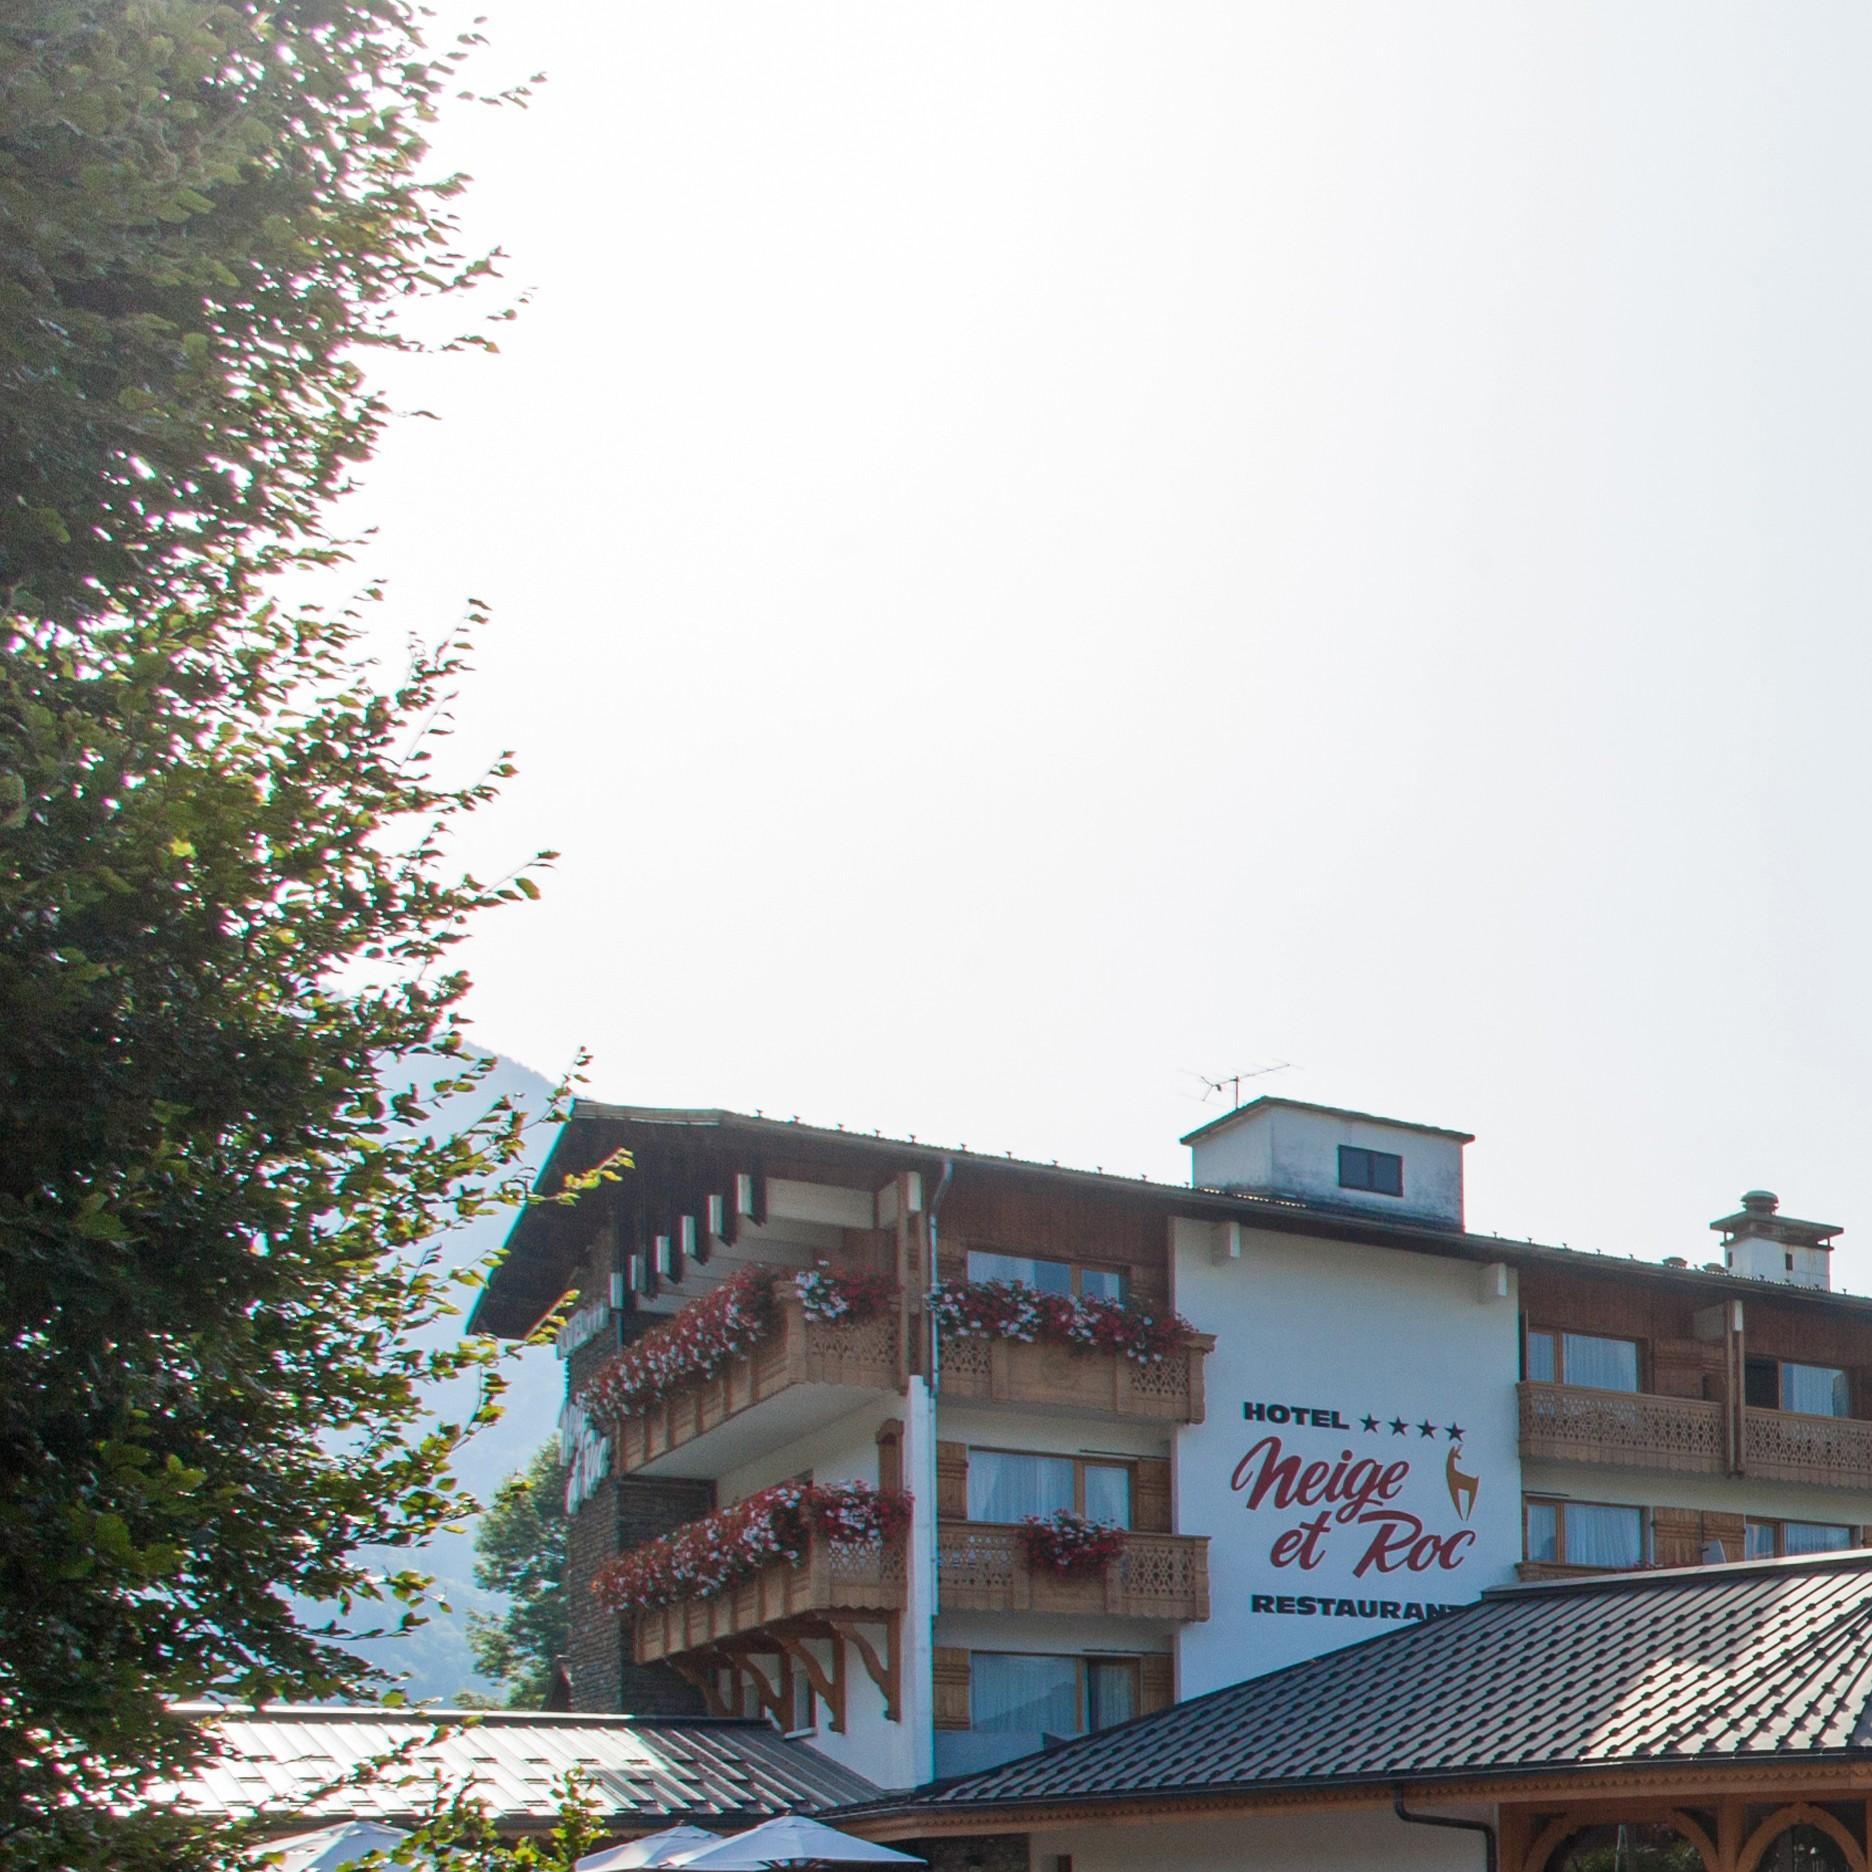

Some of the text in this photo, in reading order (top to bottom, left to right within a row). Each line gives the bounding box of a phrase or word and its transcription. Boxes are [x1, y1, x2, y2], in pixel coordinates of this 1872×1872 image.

[1243, 1402, 1350, 1430] HOTEL
[1231, 1436, 1410, 1524] Neige
[1270, 1510, 1476, 1578] et Roc
